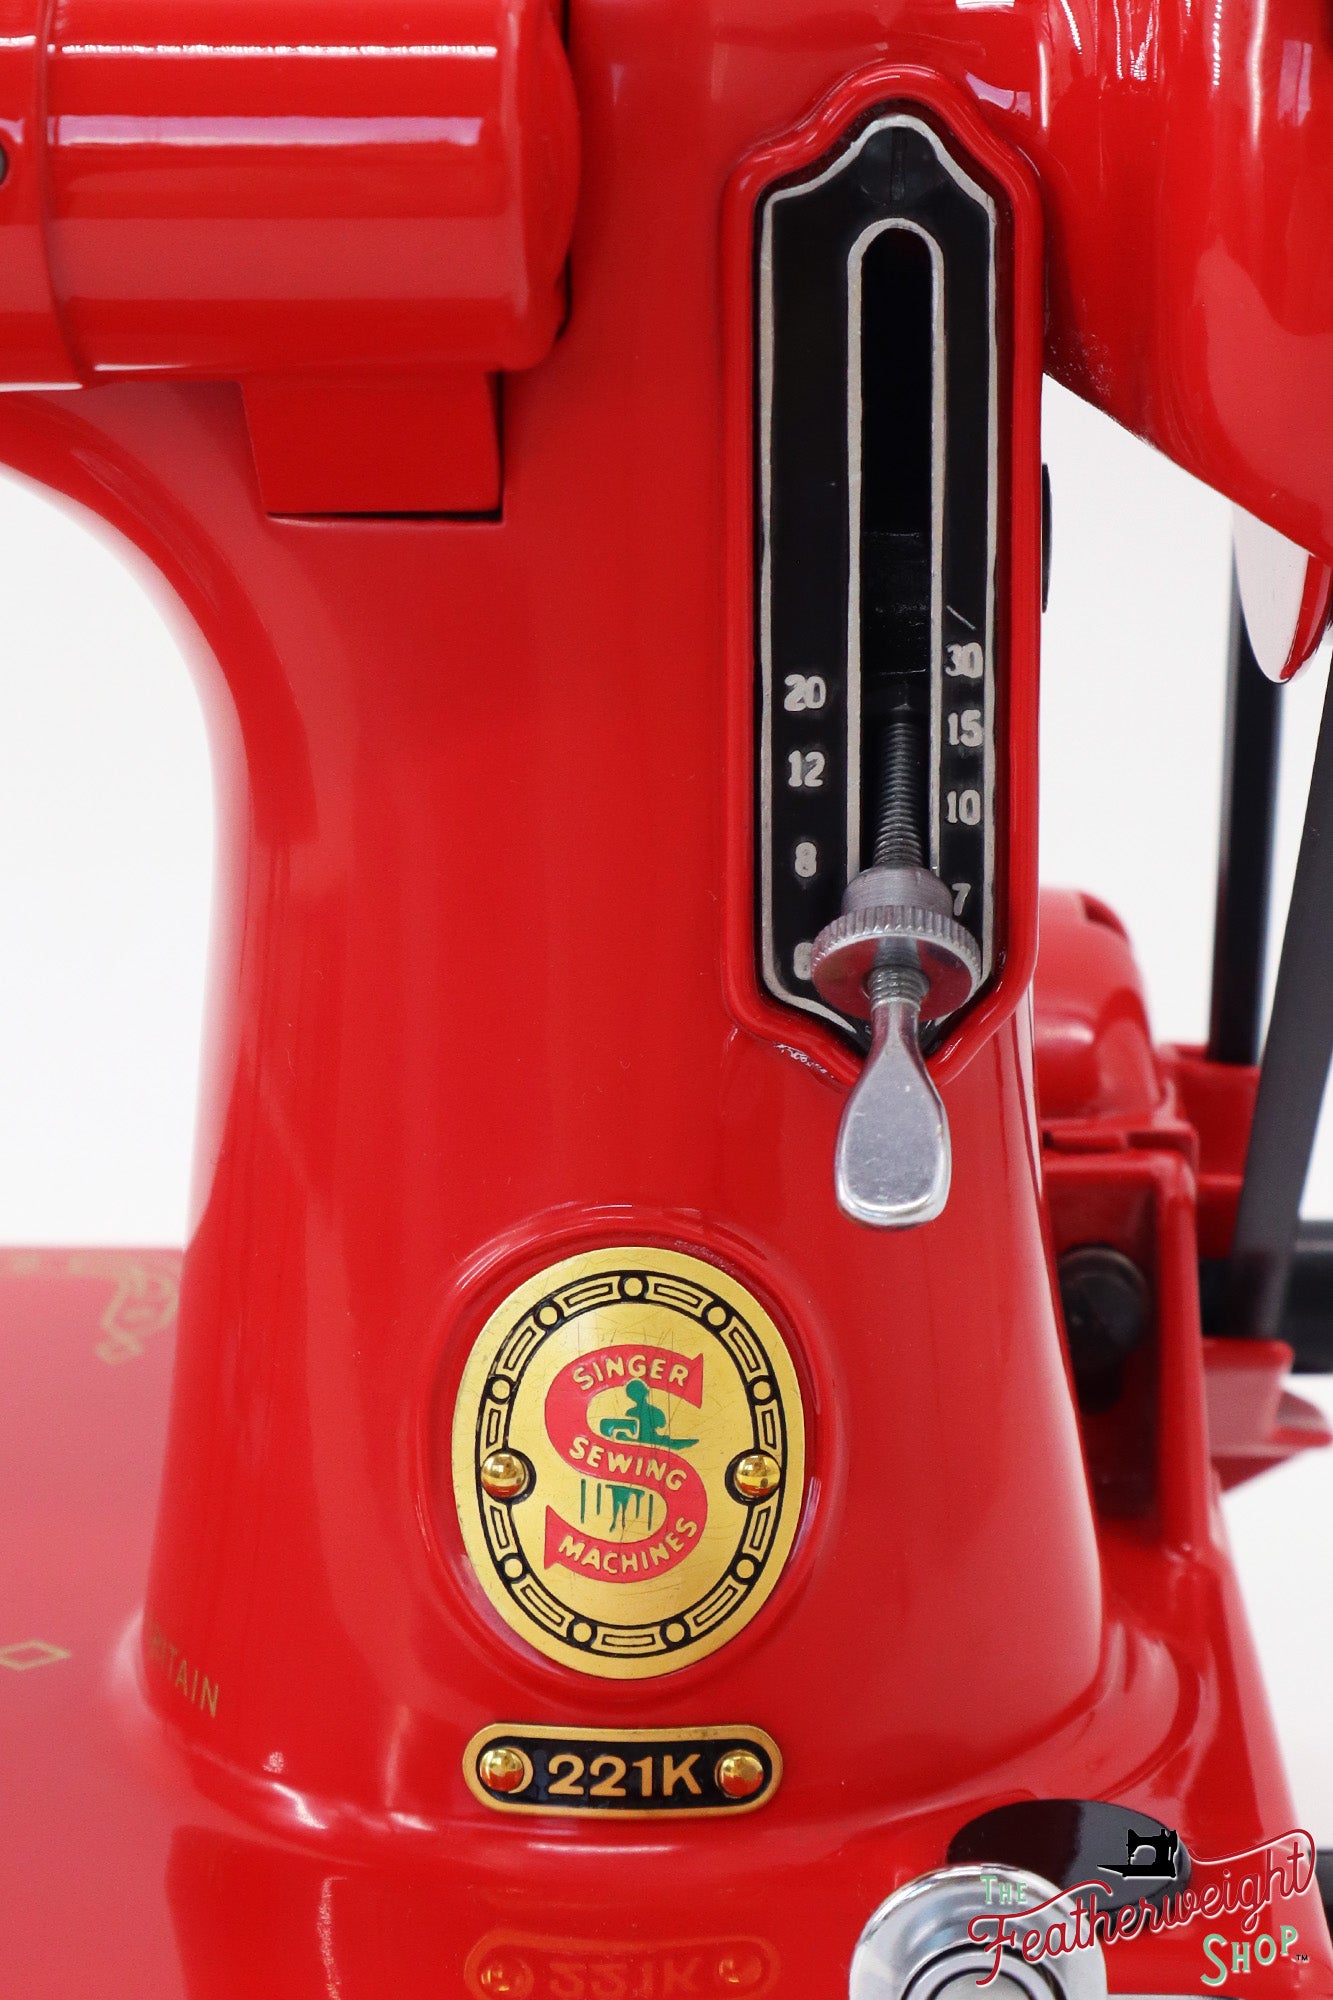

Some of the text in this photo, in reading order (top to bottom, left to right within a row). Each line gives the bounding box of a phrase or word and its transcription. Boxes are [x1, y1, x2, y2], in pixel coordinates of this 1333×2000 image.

[945, 642, 984, 679] 30
[783, 674, 826, 712] 20
[948, 709, 984, 747] 15
[788, 750, 825, 787] 12
[946, 789, 981, 825] 10
[794, 841, 817, 878] 8
[952, 882, 972, 916] 7
[573, 1353, 689, 1392] SINGER
[569, 1436, 688, 1491] SEWING
[558, 1516, 698, 1575] MACHINES
[547, 1753, 703, 1797] 221K
